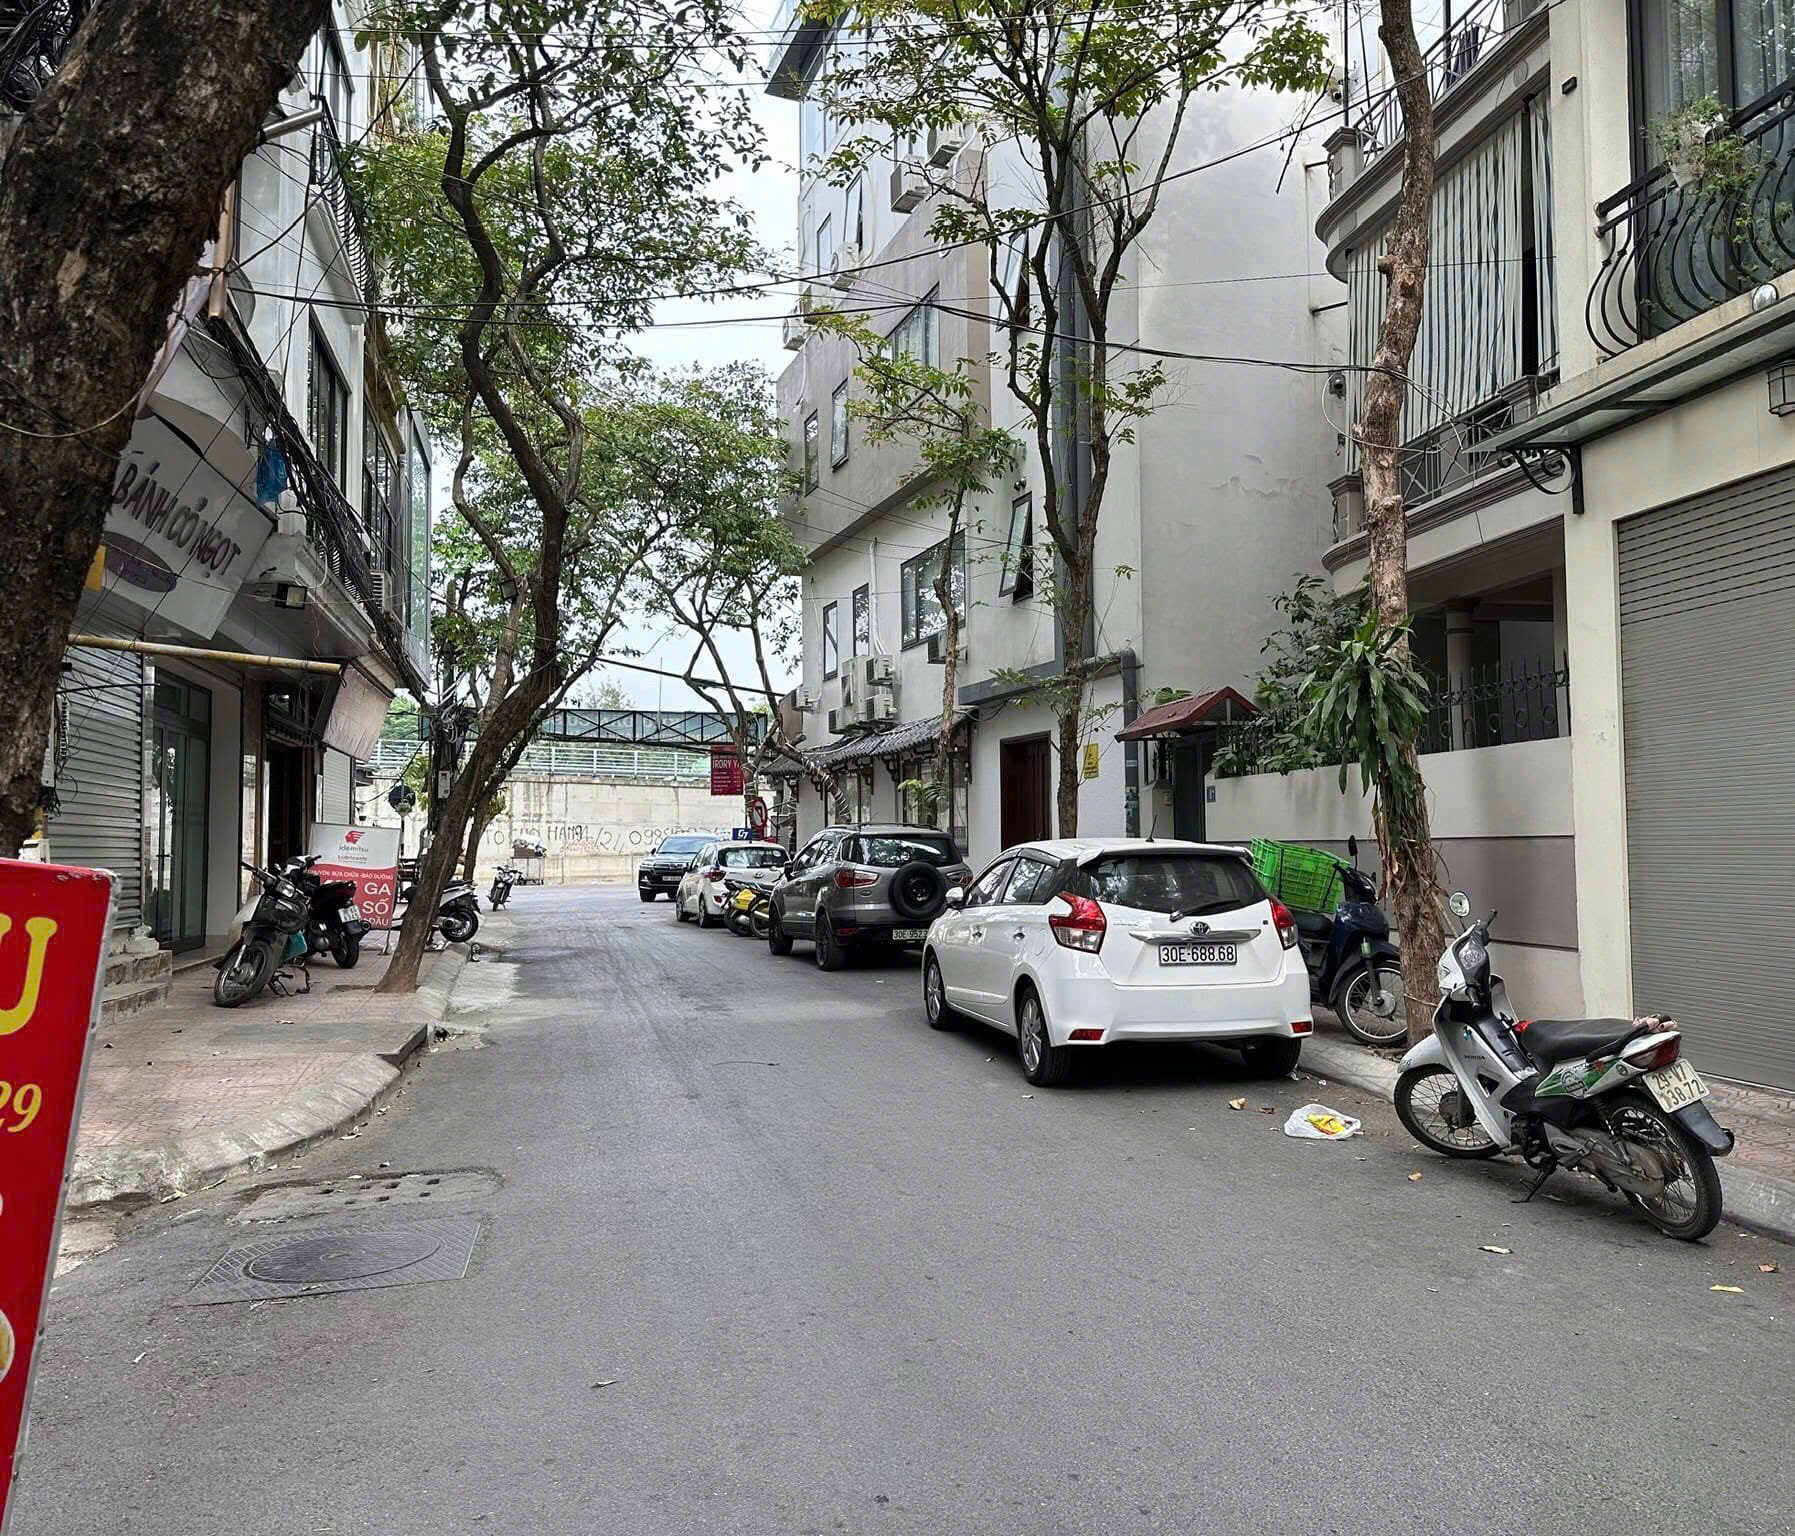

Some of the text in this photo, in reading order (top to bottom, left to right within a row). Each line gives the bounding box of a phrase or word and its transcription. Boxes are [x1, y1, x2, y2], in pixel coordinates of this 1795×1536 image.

[111, 462, 178, 535] BÁNH
[339, 845, 369, 853] idemitsu
[364, 882, 391, 896] GA
[361, 898, 389, 915] SỐ
[1652, 1063, 1687, 1091] 29-V7
